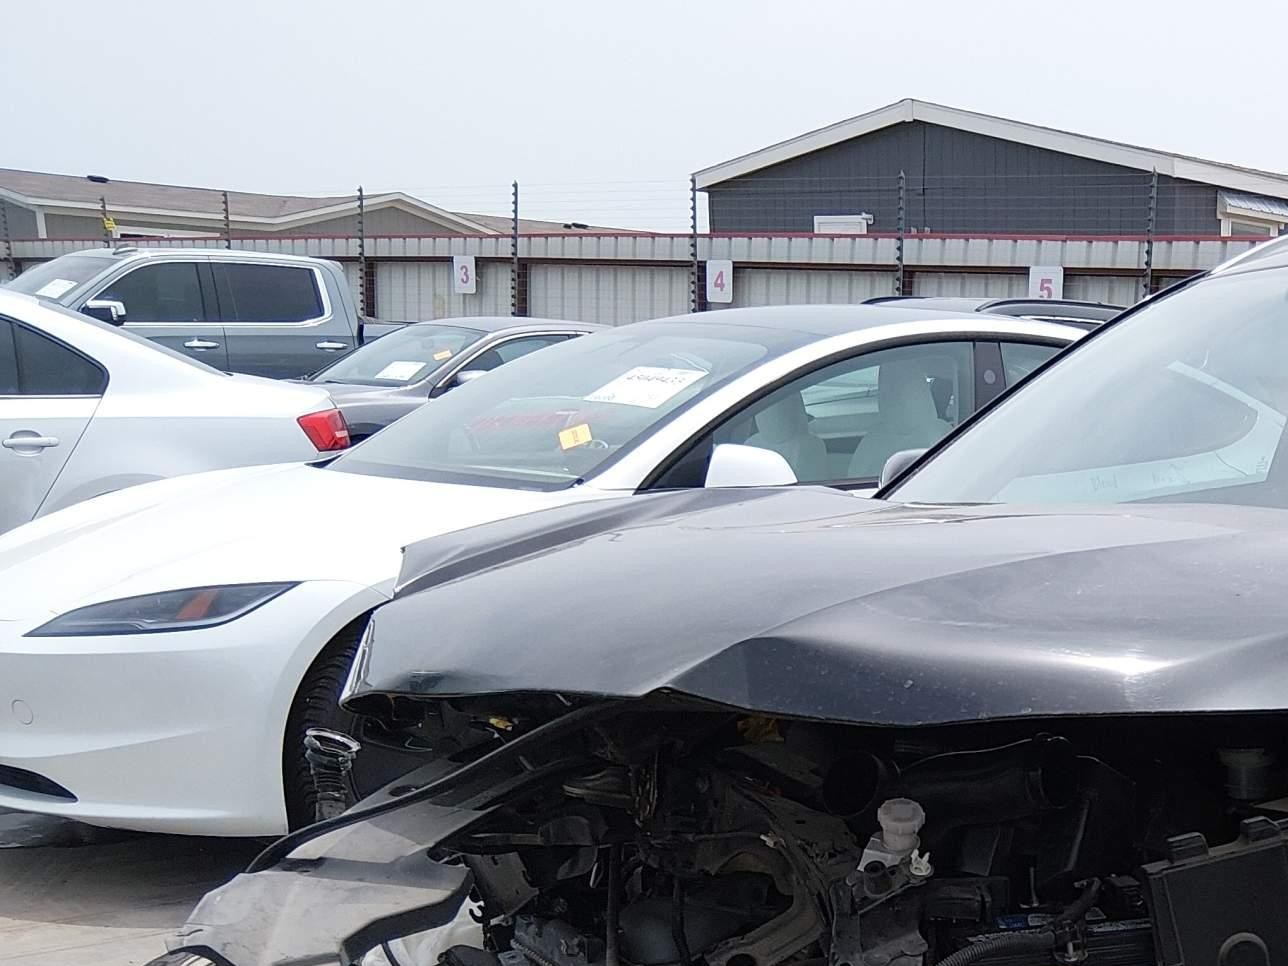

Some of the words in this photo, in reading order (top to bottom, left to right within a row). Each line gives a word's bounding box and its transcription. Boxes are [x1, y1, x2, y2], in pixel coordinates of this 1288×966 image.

[460, 264, 470, 284] 3
[713, 270, 726, 292] 4
[1039, 278, 1053, 299] 5
